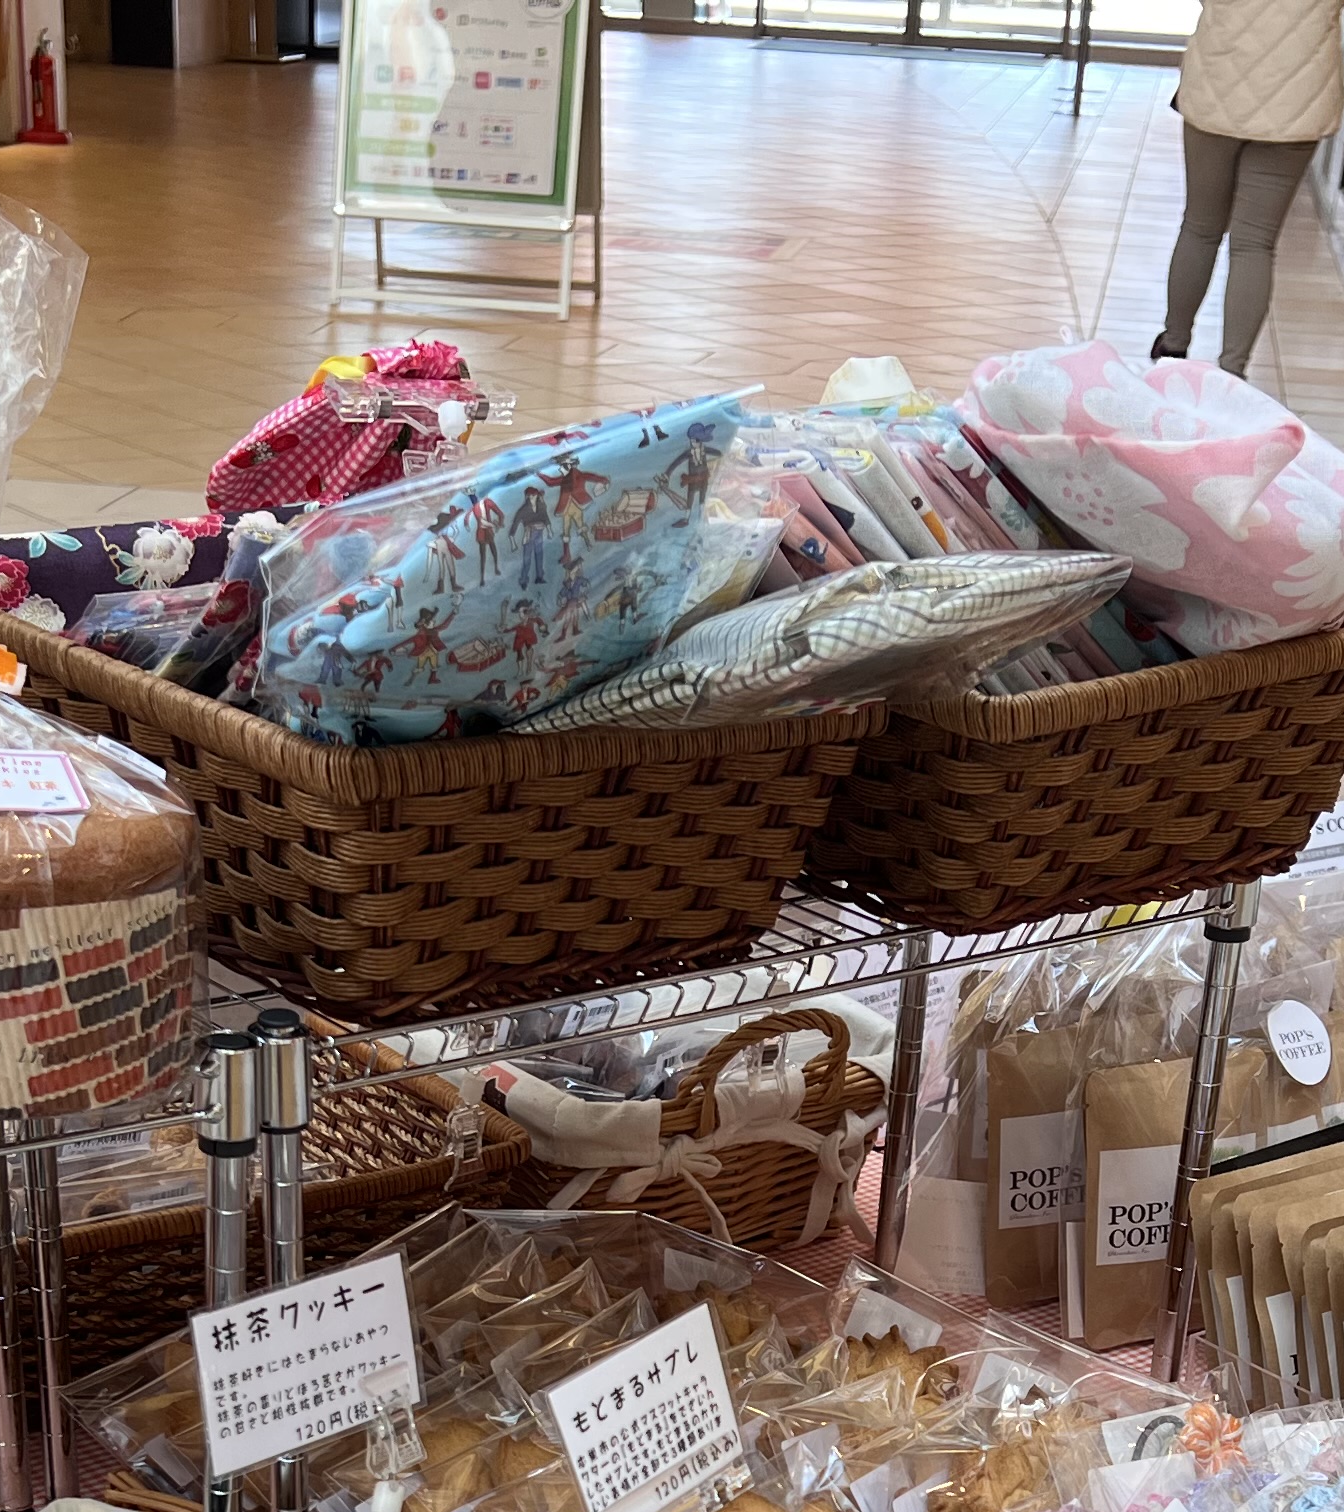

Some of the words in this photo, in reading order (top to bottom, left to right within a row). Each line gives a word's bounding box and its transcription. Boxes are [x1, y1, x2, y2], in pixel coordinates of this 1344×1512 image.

[1278, 1041, 1327, 1062] COFFEE
[211, 1282, 385, 1353] 抹茶クッキー
[212, 1323, 390, 1393] 抹茶好きにはたまらないおやつ
[573, 1340, 699, 1434] もとまるサブレ
[215, 1391, 248, 1408] です。
[655, 1430, 739, 1502] 120円(税込み)
